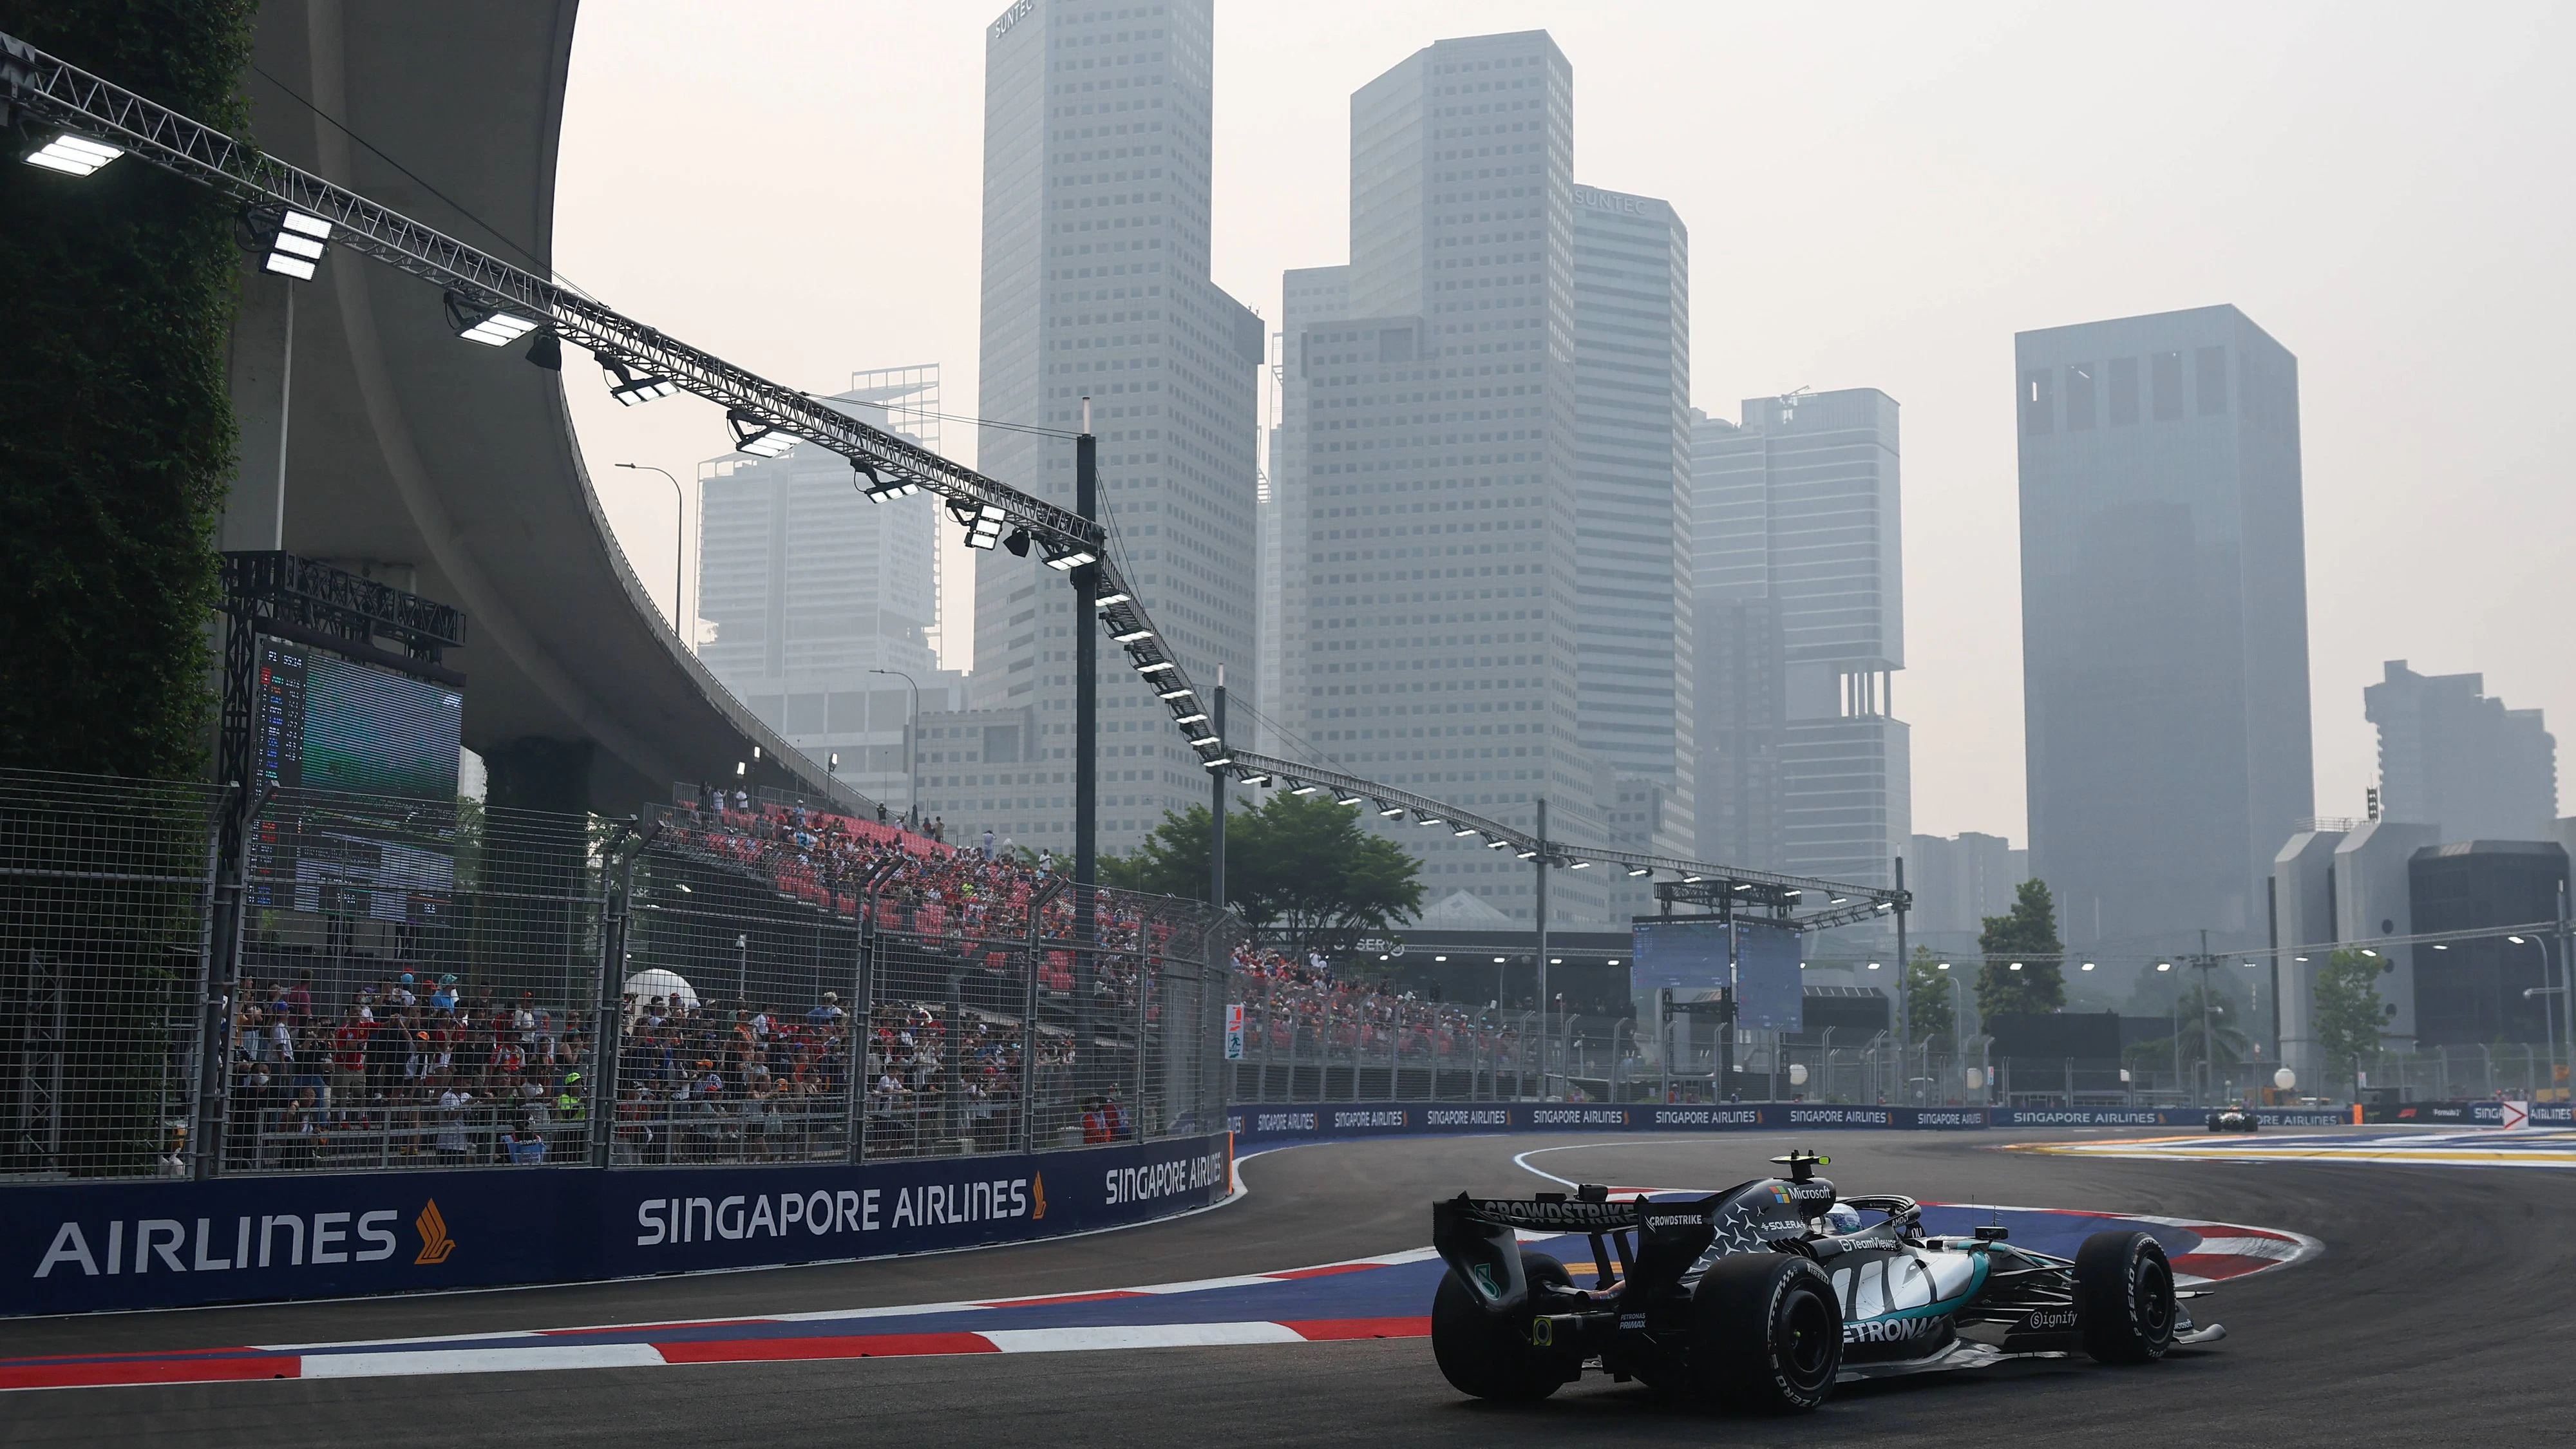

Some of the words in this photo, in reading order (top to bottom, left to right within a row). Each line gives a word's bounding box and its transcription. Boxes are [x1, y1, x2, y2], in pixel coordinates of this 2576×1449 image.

[995, 0, 1033, 39] SUNTEC
[1575, 189, 1646, 215] SUNTEC
[1334, 1111, 1370, 1128] SINGAPORE
[1371, 1110, 1402, 1127] AIRLINES
[1427, 1110, 1469, 1126] SINGAPORE
[1470, 1110, 1506, 1124] AIRLINES
[1533, 1110, 1581, 1124] SINGAPORE
[1582, 1110, 1622, 1124] AIRLINES
[1655, 1111, 1709, 1124] SINGAPORE
[1711, 1110, 1755, 1124] AIRLINES
[1790, 1110, 1843, 1123] SINGAPORE
[1844, 1110, 1886, 1124] AIRLINES
[1917, 1113, 1960, 1124] SINGAPORE
[2013, 1112, 2090, 1124] SINGAPORE
[2095, 1112, 2155, 1124] AIRLINES
[2284, 1115, 2337, 1126] AIRLINES
[2474, 1108, 2505, 1120] SINGA
[2530, 1108, 2571, 1120] AIRLINES
[1106, 1160, 1186, 1205] SINGAPORE
[1788, 1186, 1831, 1202] Microsoft
[638, 1188, 881, 1246] SINGAPORE
[891, 1177, 1027, 1229] AIRLINES
[1484, 1200, 1636, 1224] CROWDSTRIKE
[1649, 1215, 1703, 1226] CROWDSTRIKE
[1768, 1220, 1803, 1230] SOLERA
[33, 1209, 398, 1278] AIRLINES
[1849, 1236, 1897, 1249] TeamViewer
[1806, 1262, 1829, 1285] PIRELLI
[2127, 1267, 2138, 1323] ZERO
[1619, 1320, 1646, 1330] PRIMAX
[1843, 1316, 1940, 1343] ETRONAS
[1776, 1375, 1811, 1407] ZERO
